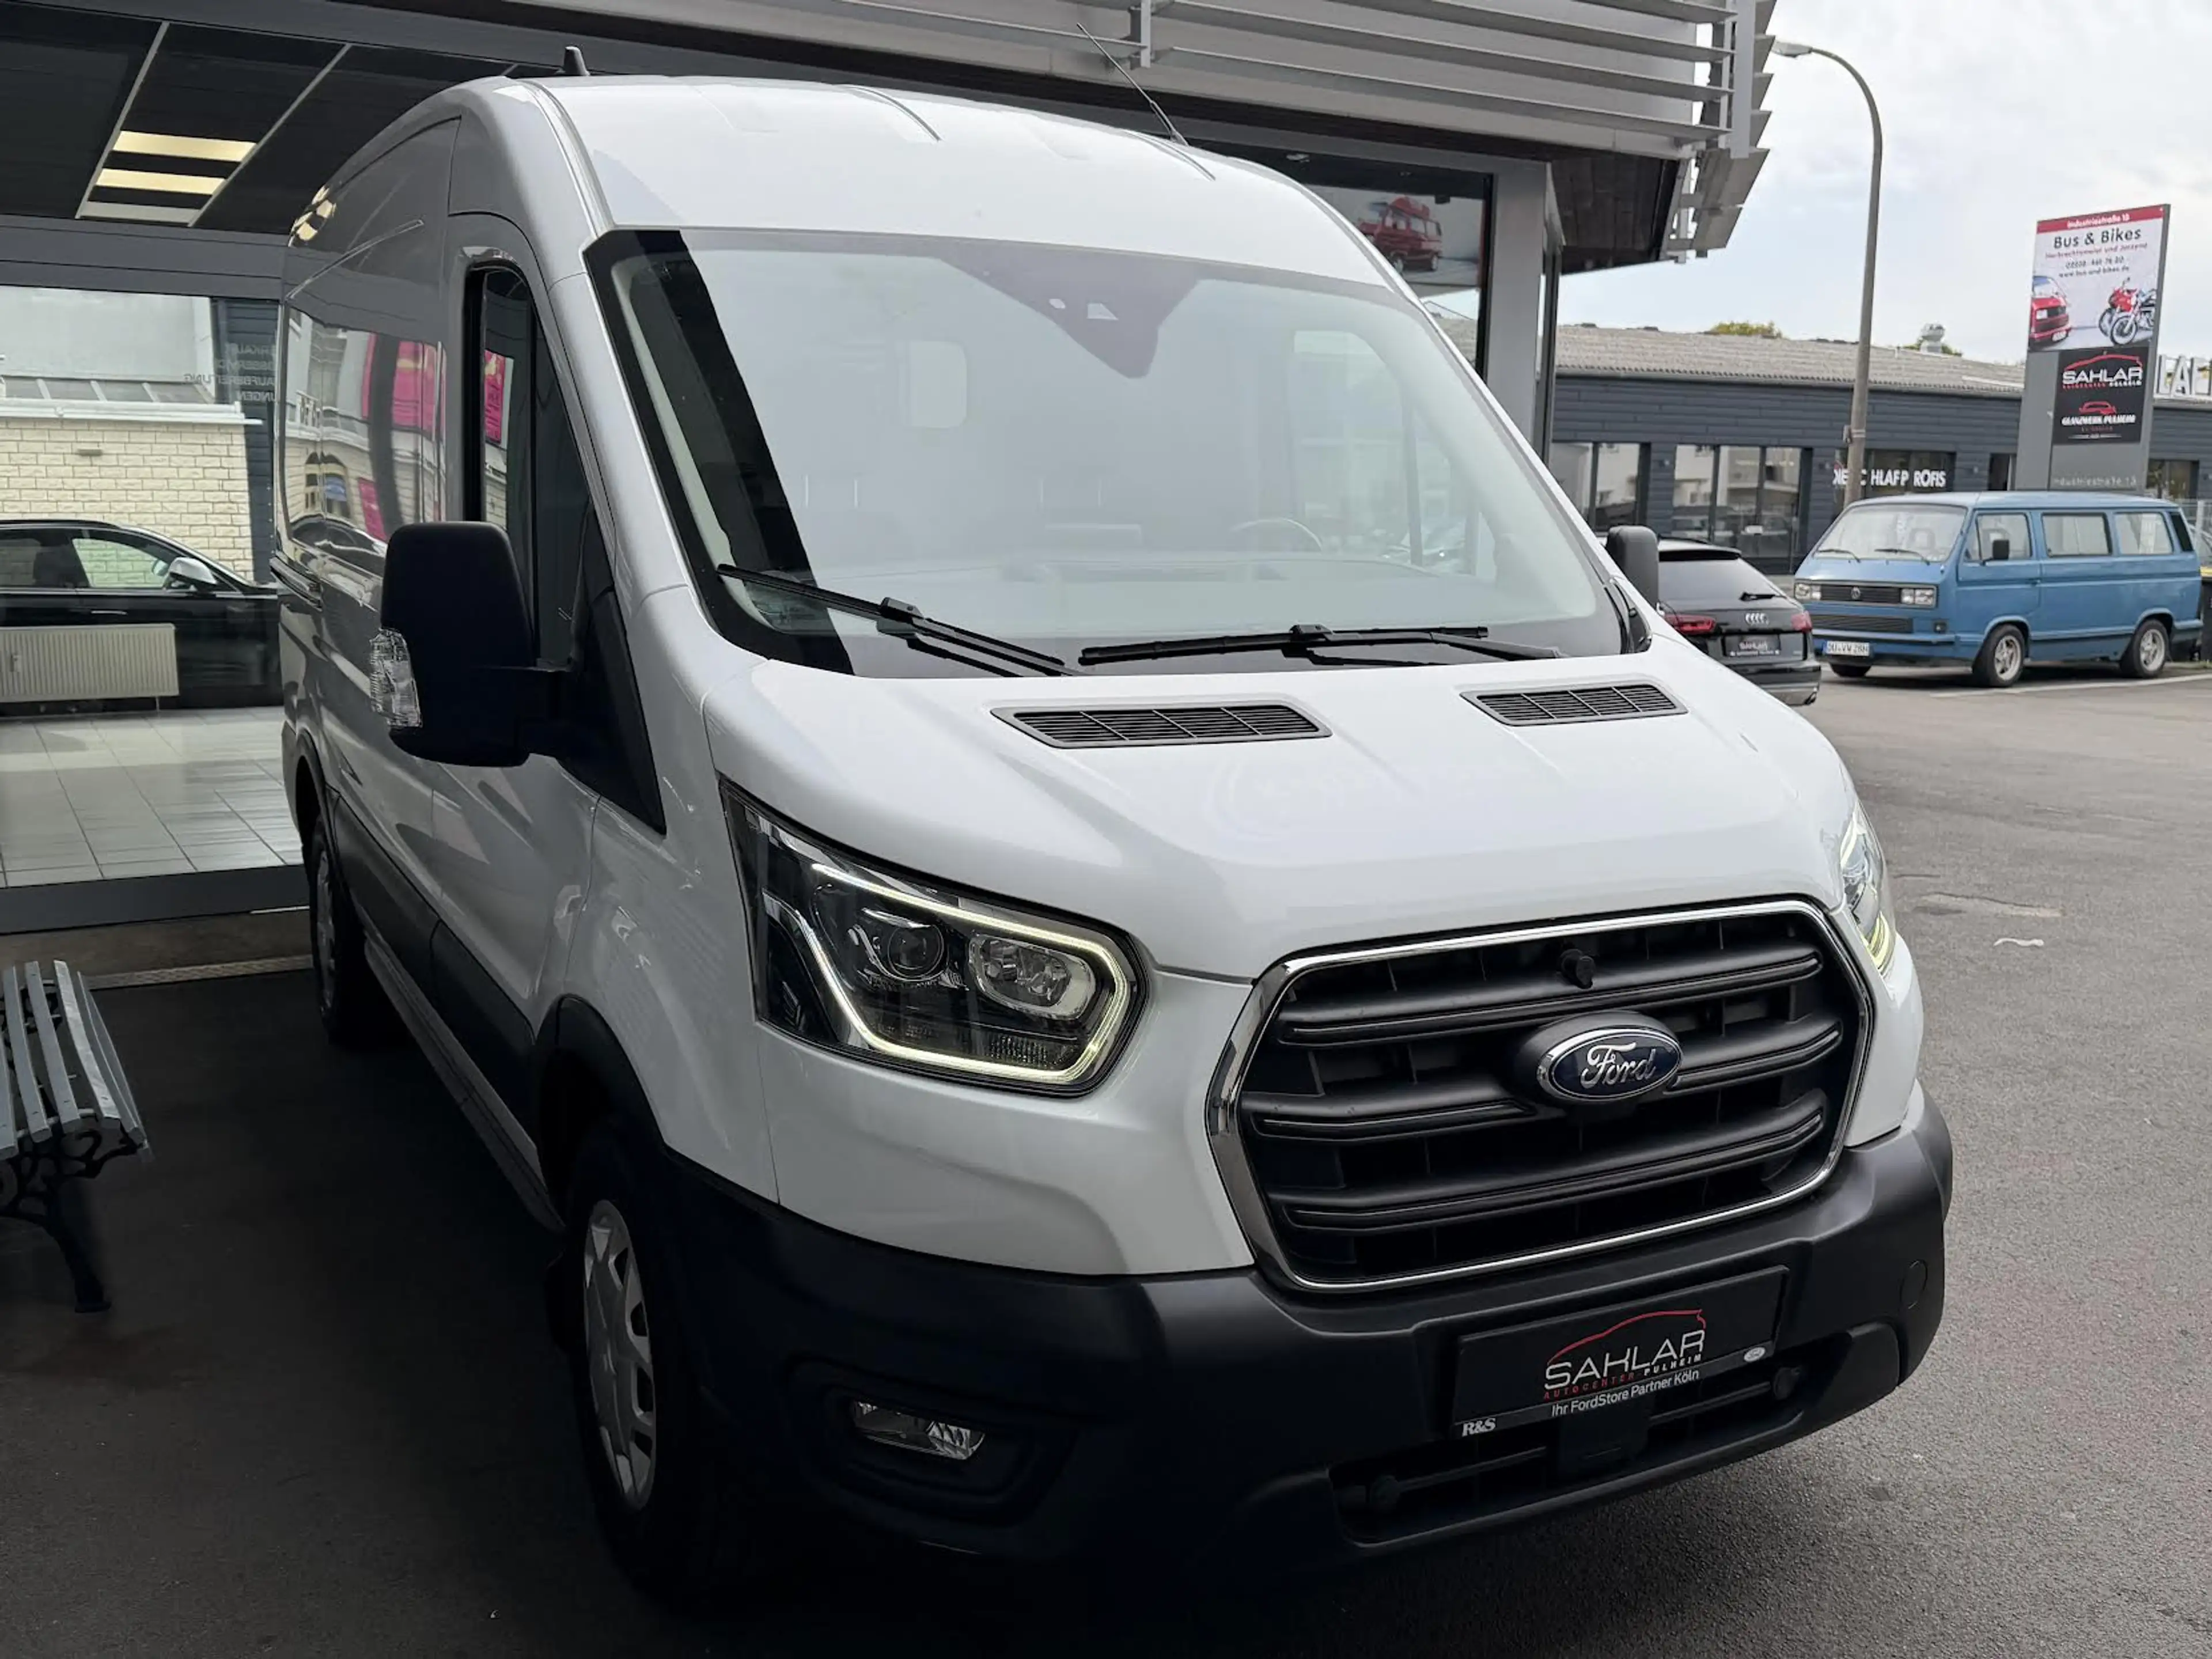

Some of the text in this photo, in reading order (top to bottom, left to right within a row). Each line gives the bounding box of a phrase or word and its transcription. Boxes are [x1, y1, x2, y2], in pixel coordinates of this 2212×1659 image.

[2054, 228, 2142, 249] Bus & Bikes
[2062, 366, 2142, 384] SAHLAR
[1581, 1041, 1656, 1089] Ford
[1543, 1354, 1702, 1400] AUTOCENTER PULHEIM
[1544, 1330, 1705, 1390] SAHLAR
[1551, 1369, 1700, 1418] Ihr FordStore Partner Köln
[1462, 1417, 1497, 1437] R&S
